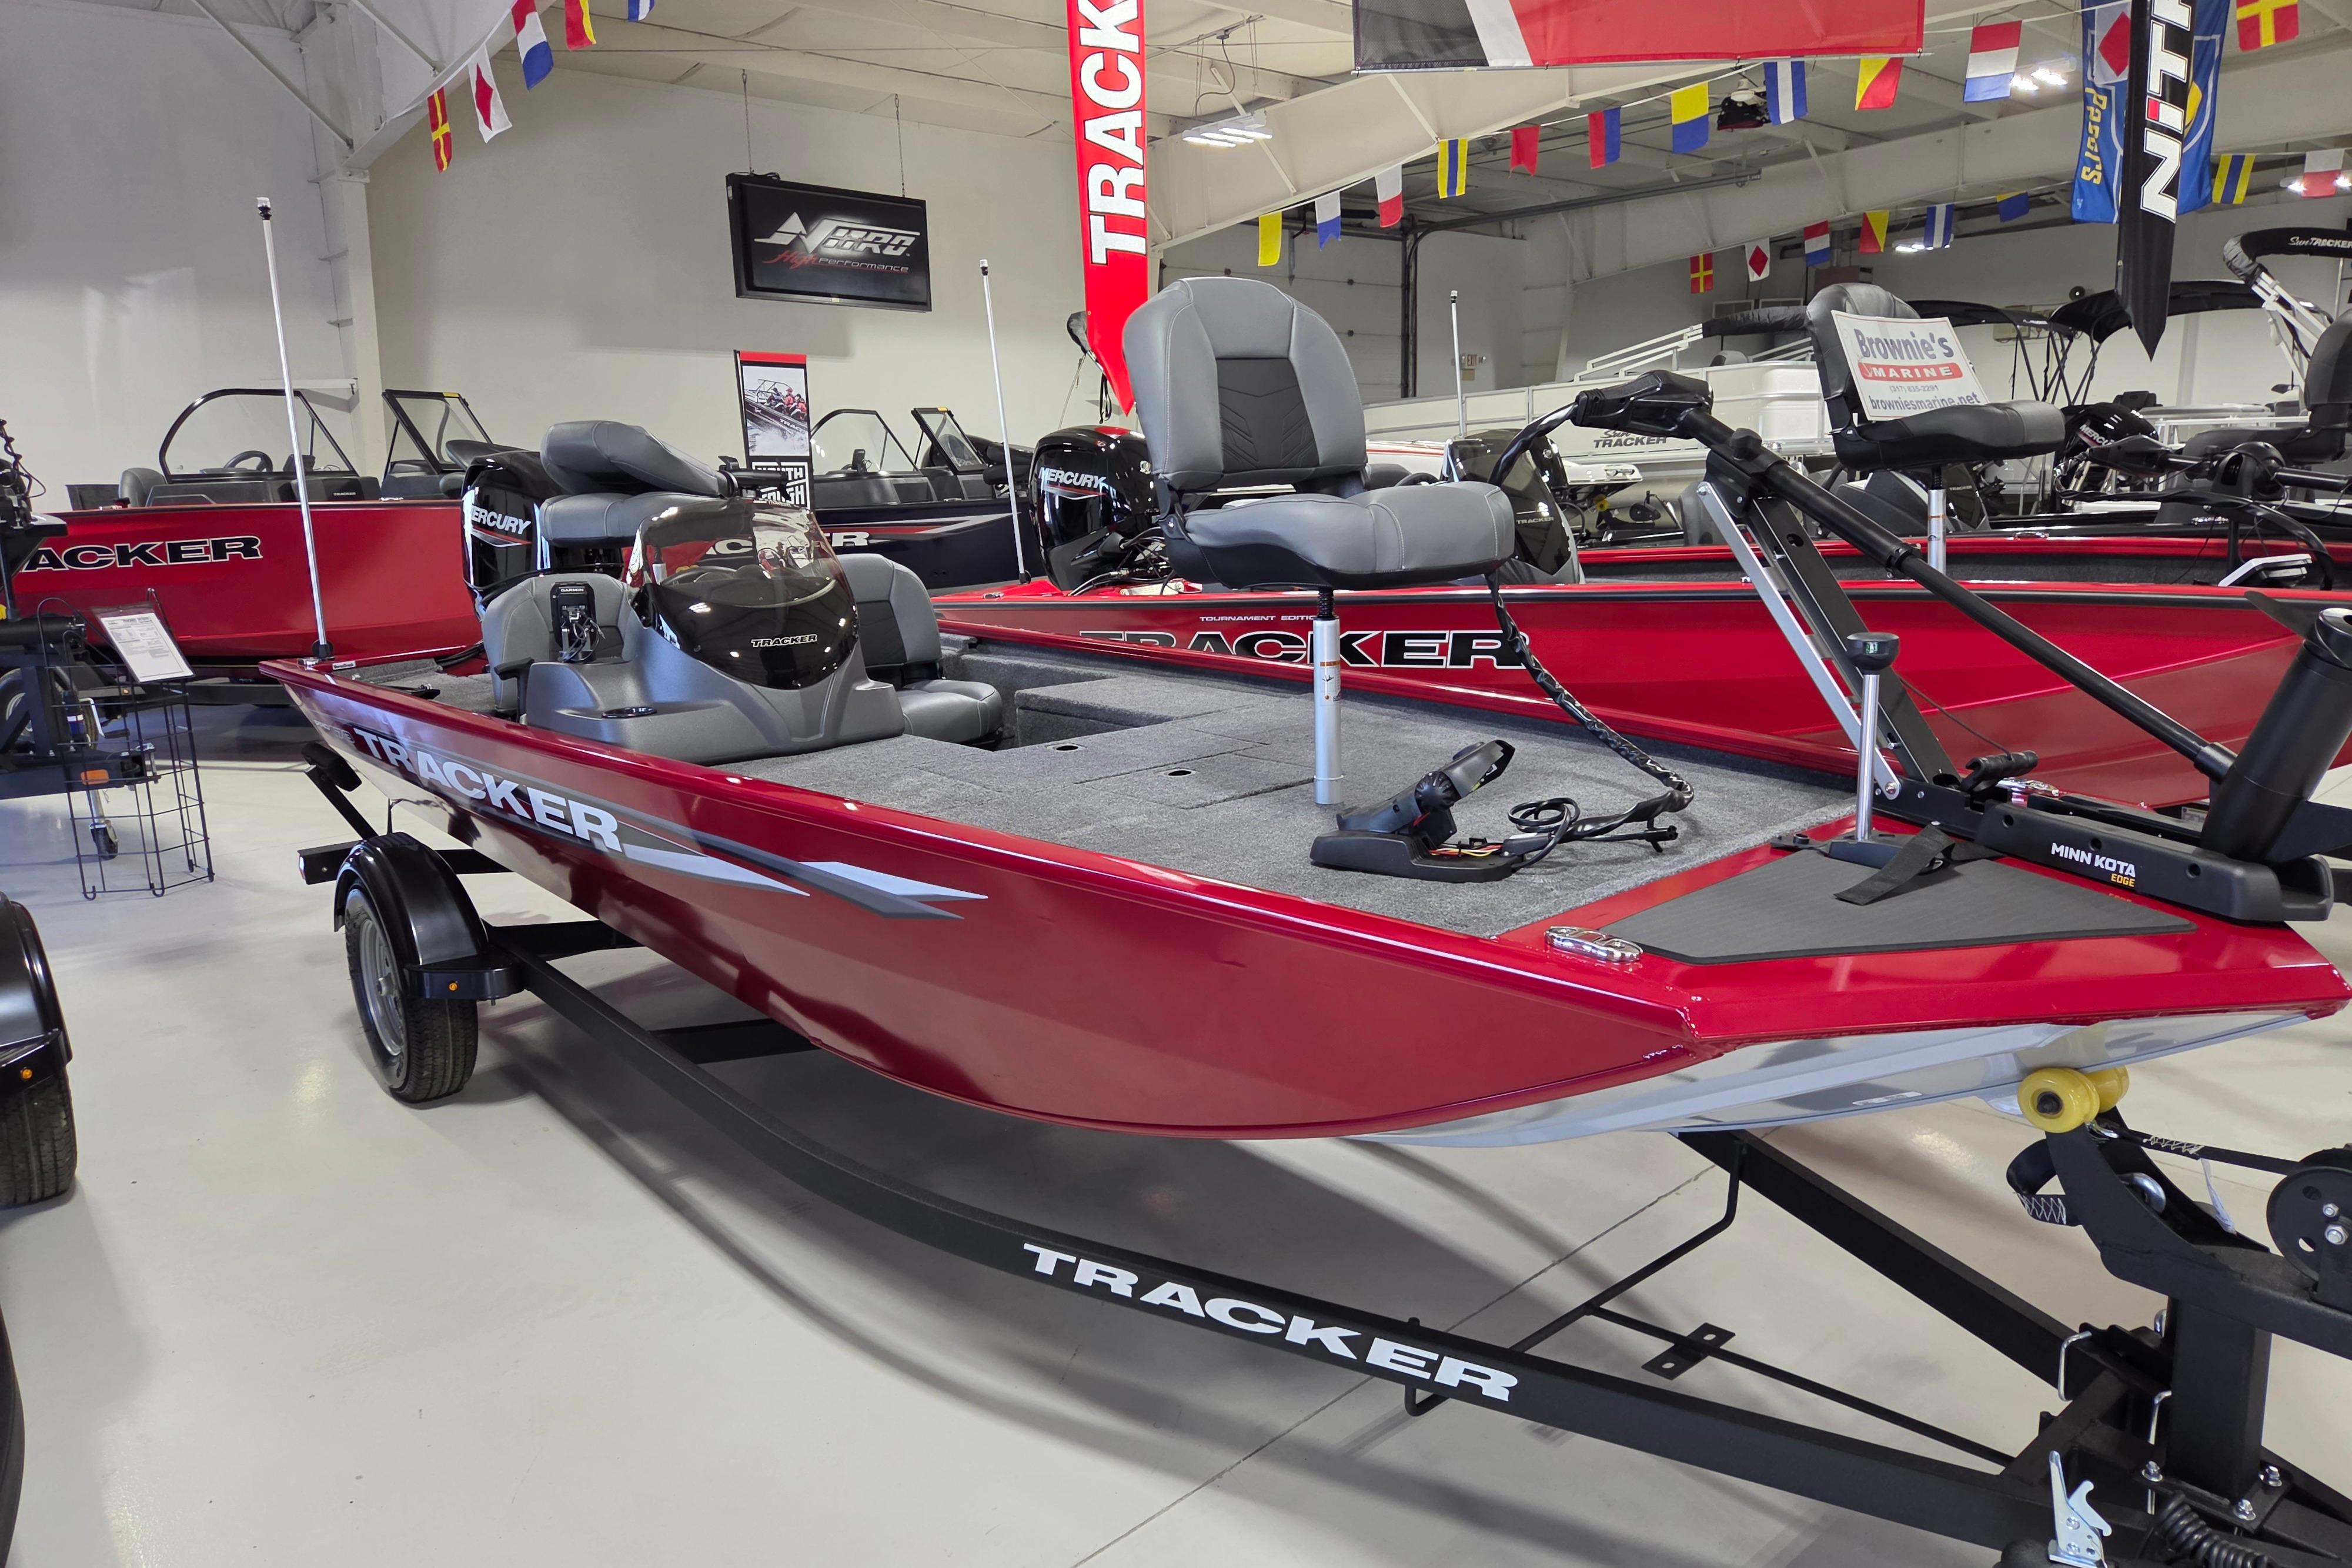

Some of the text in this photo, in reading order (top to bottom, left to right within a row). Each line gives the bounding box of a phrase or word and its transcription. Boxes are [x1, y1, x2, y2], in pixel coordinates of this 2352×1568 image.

[1853, 328, 1955, 360] Brownie's
[1467, 354, 1478, 367] EXIT
[1872, 366, 1953, 379] MARINE
[1593, 436, 1667, 449] TRACKER
[2079, 424, 2116, 446] MERCU
[1038, 467, 1107, 489] MERCURY
[470, 504, 532, 535] ERCURY
[22, 535, 263, 573] ACKER
[751, 634, 817, 647] TRACKER
[353, 727, 623, 852] TRACKER
[2051, 842, 2136, 878] MINN KOTA
[2110, 873, 2136, 888] EDGE
[1023, 1243, 1518, 1402] TRACKER
